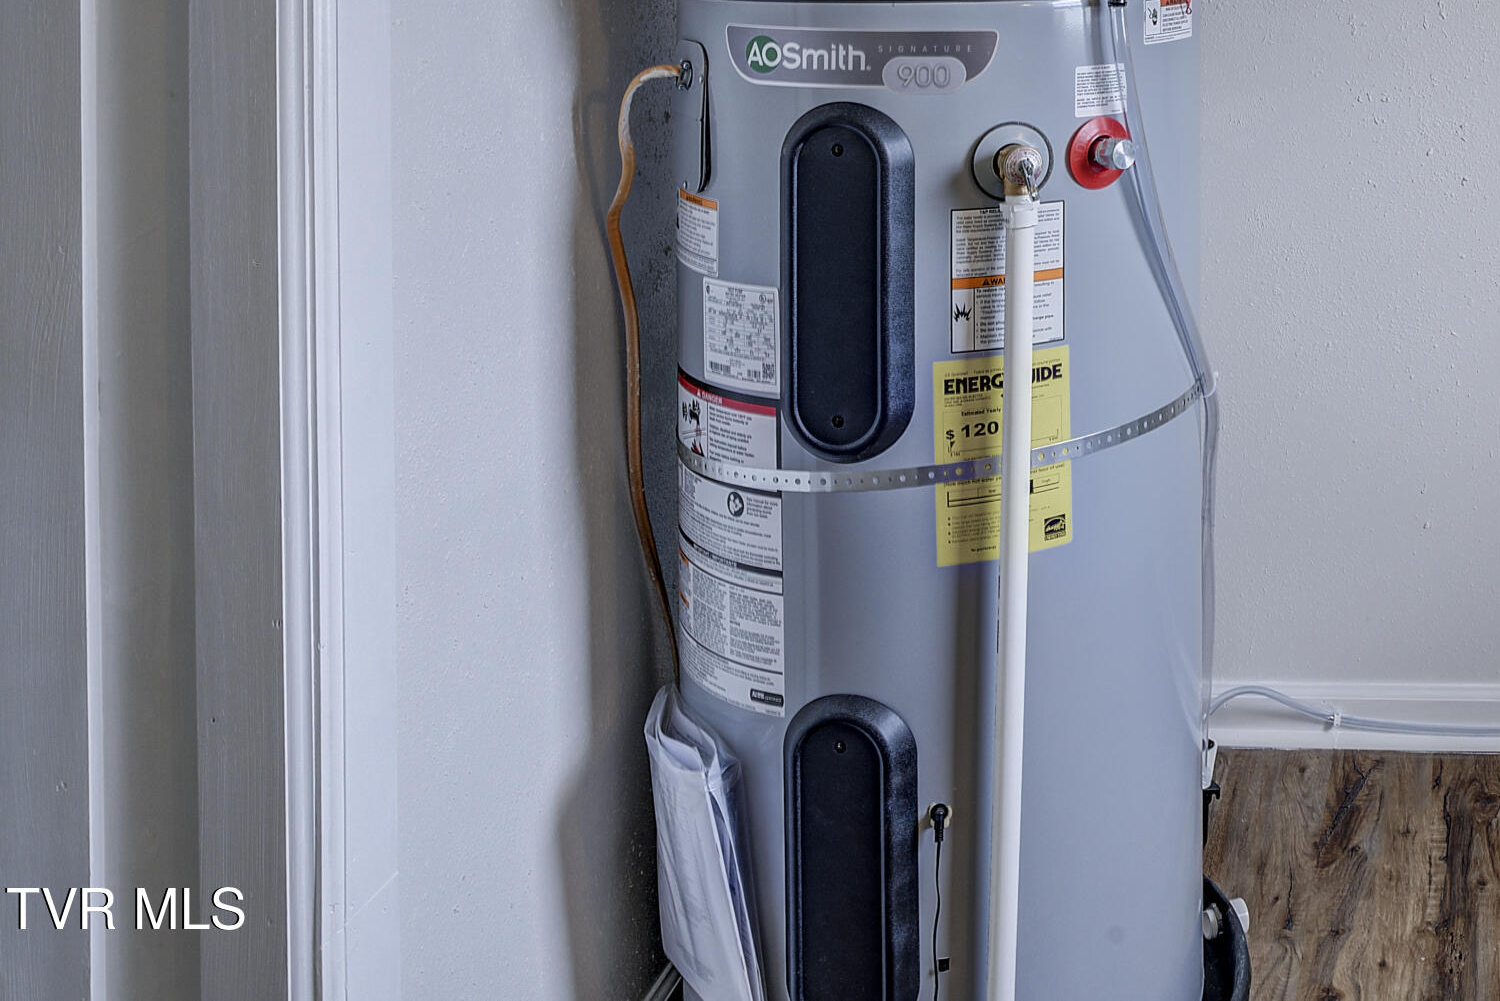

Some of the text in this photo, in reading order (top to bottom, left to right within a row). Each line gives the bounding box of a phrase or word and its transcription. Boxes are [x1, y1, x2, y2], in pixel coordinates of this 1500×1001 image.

[878, 45, 973, 53] SIGNATURE
[898, 62, 951, 88] 900
[944, 373, 1004, 395] ENERG
[945, 421, 999, 440] $ 120
